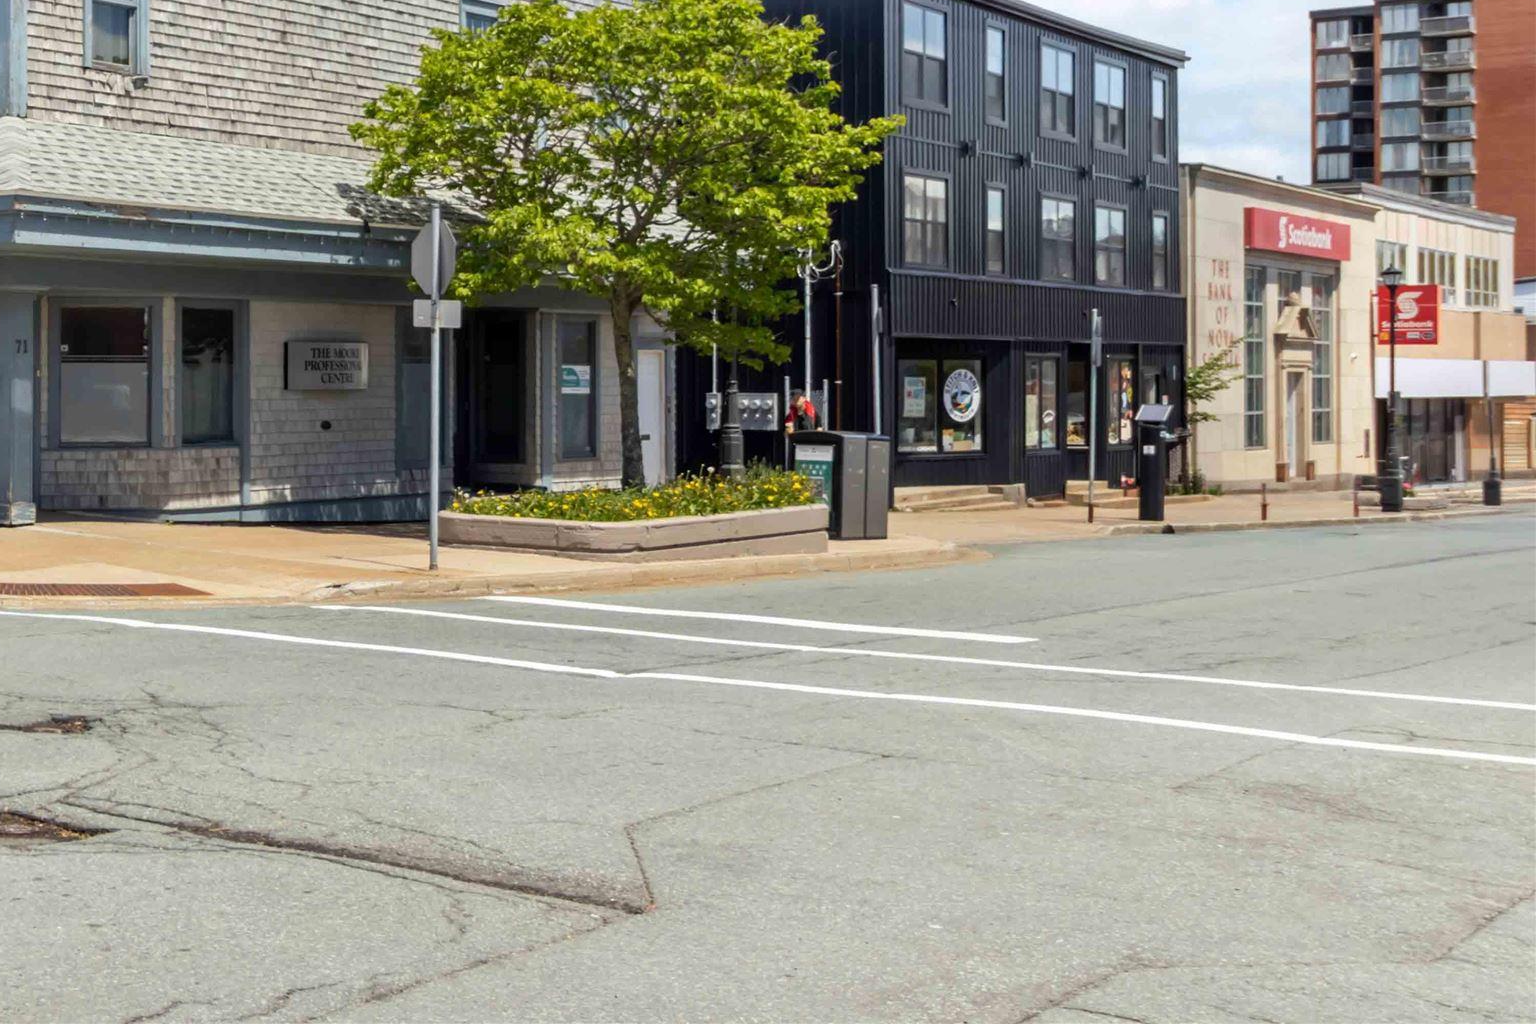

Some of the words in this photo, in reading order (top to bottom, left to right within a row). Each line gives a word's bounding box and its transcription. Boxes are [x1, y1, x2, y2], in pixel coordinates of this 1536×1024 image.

[1288, 223, 1333, 250] Scotiabank
[1212, 259, 1229, 279] THE
[1208, 282, 1232, 301] BANK
[1216, 306, 1228, 325] OF
[1381, 320, 1433, 328] Sctiabank
[15, 339, 28, 354] 71
[310, 347, 331, 359] THE
